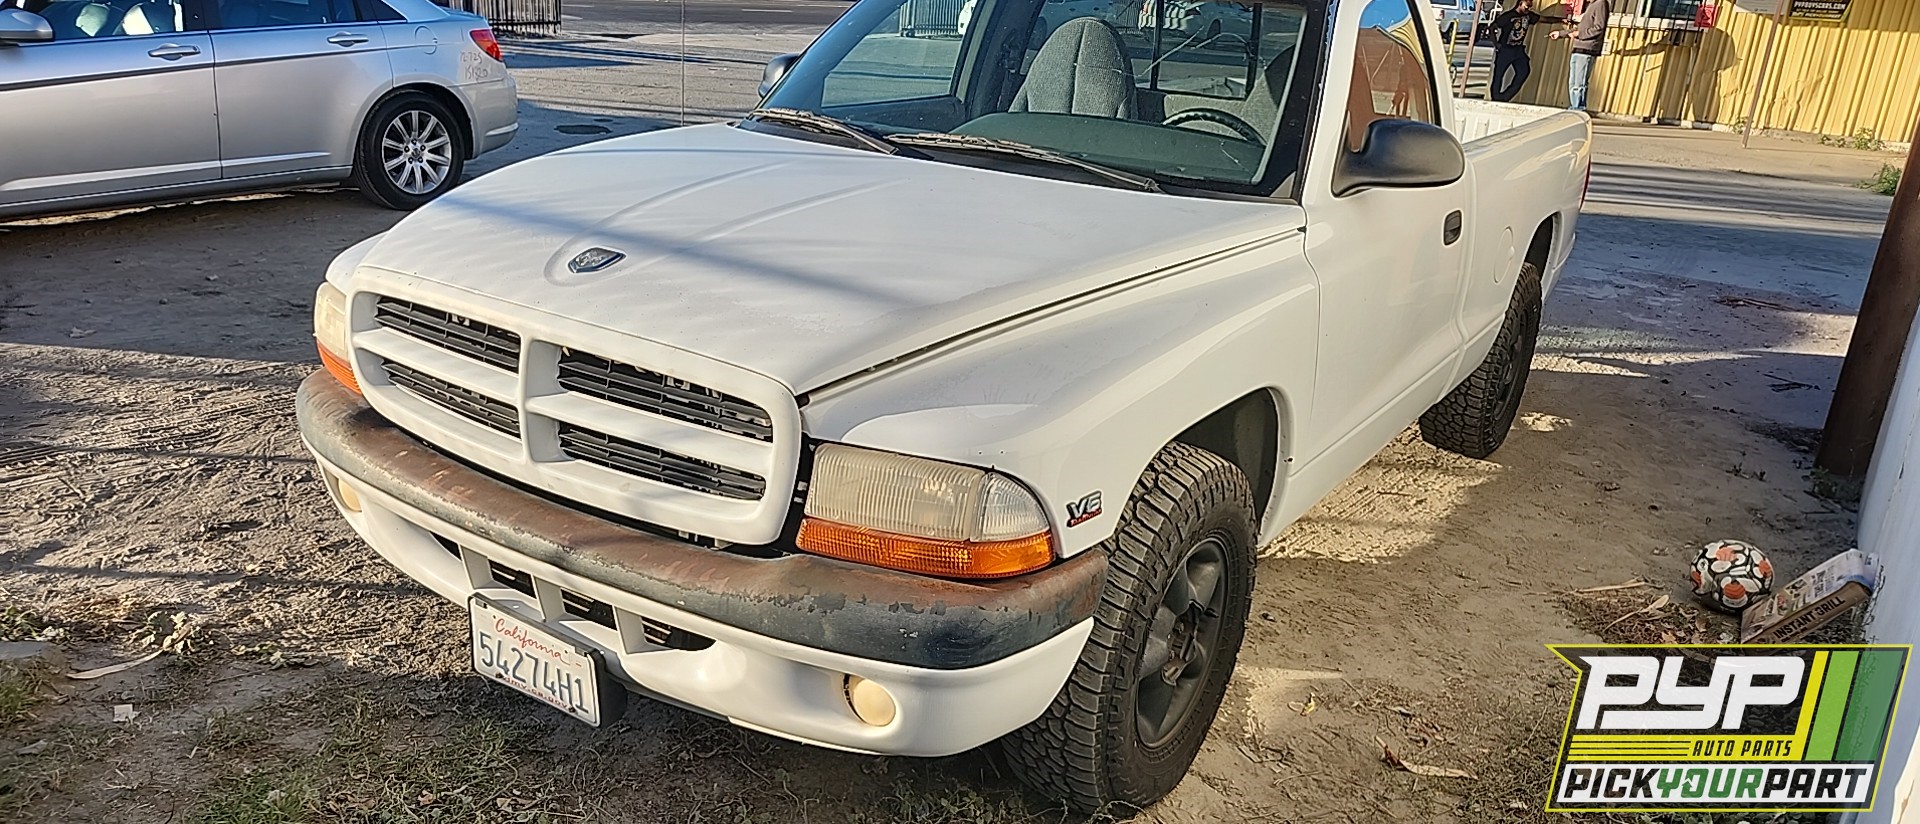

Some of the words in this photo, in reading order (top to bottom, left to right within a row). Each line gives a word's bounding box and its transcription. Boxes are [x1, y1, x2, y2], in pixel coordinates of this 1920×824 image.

[1066, 490, 1102, 519] V6
[1773, 610, 1817, 639] INSTANT
[494, 617, 571, 666] California
[479, 631, 589, 714] 54274H1
[504, 676, 568, 709] dmv.ca.gov
